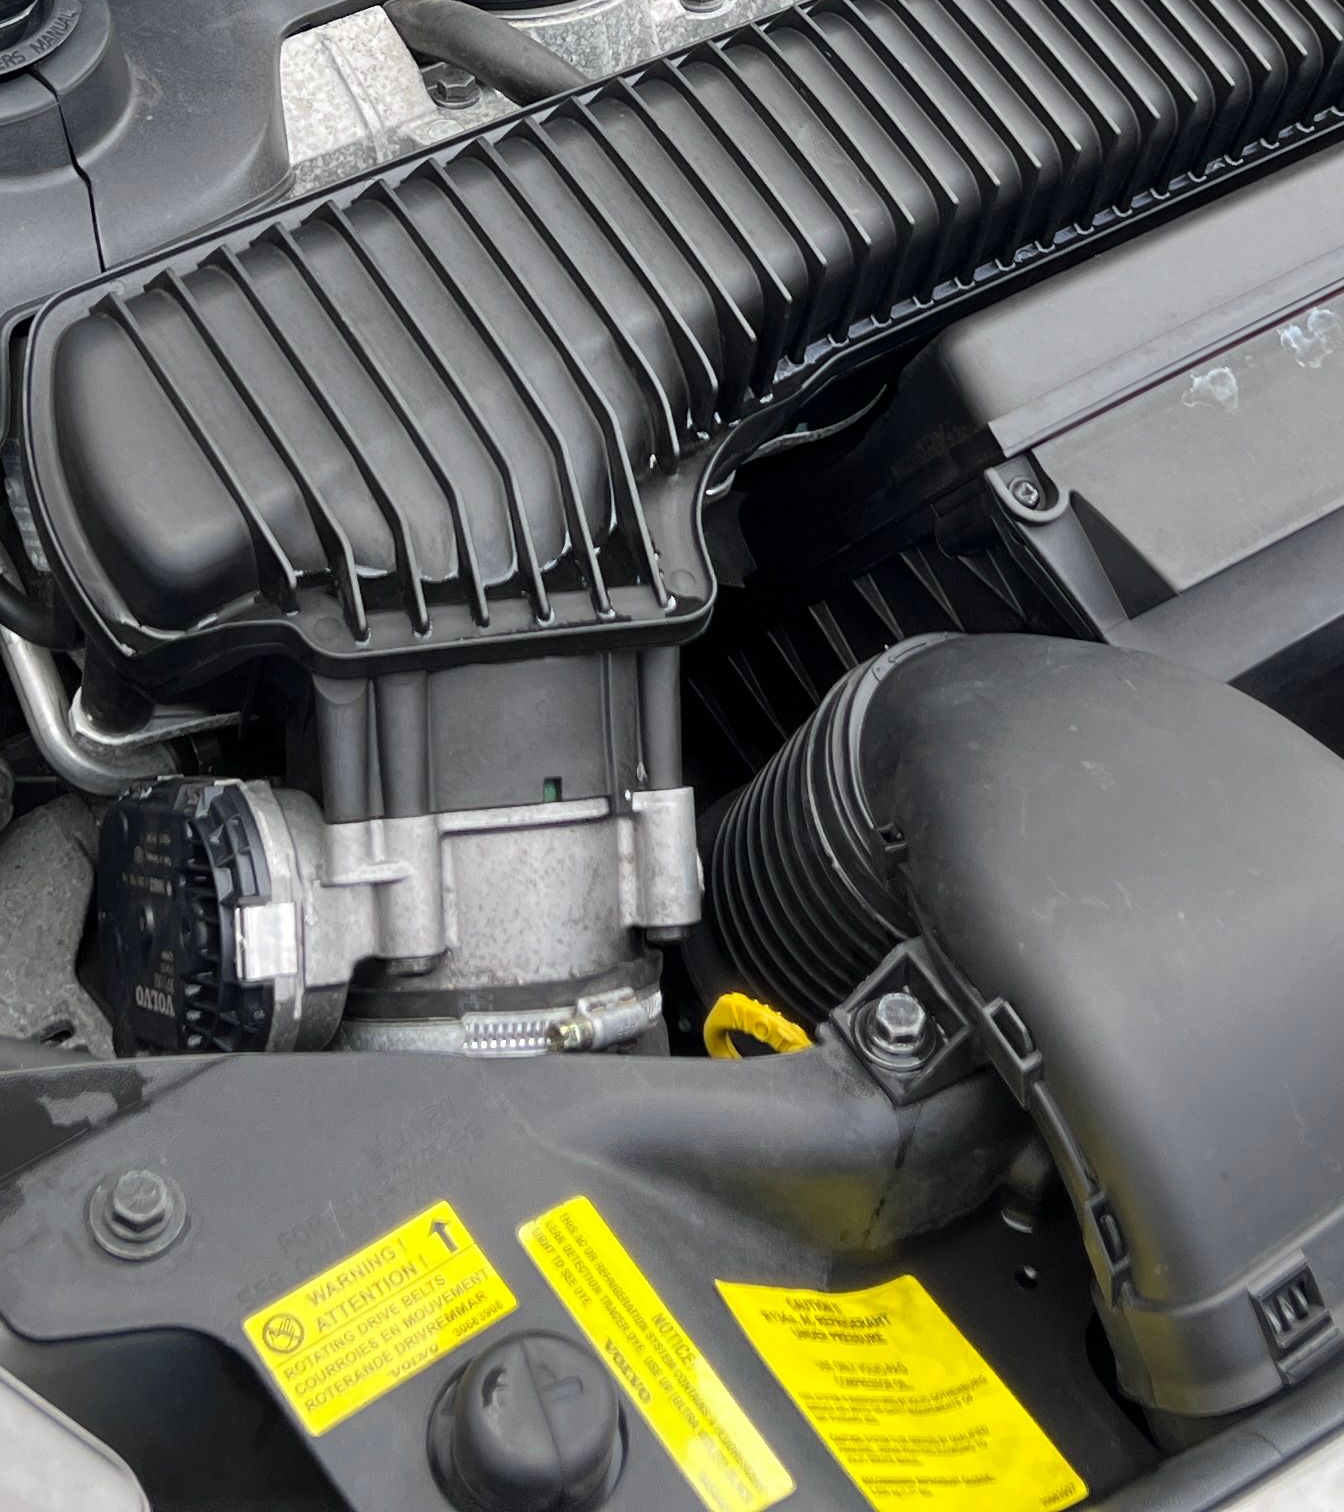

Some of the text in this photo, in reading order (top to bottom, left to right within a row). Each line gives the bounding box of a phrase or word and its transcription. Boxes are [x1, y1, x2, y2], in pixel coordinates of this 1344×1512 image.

[29, 8, 77, 55] MANUAL
[135, 984, 176, 1018] VOLVO
[304, 1242, 398, 1308] WARNING
[311, 1259, 419, 1334] ATTENTION
[281, 1271, 448, 1383] ROTATING DRIVE BELTS
[291, 1265, 491, 1398] COURROIES EN MOUVEMENT
[302, 1287, 489, 1414] ROTERANDE DRIVREMMAR
[602, 1335, 652, 1406] VOLVO
